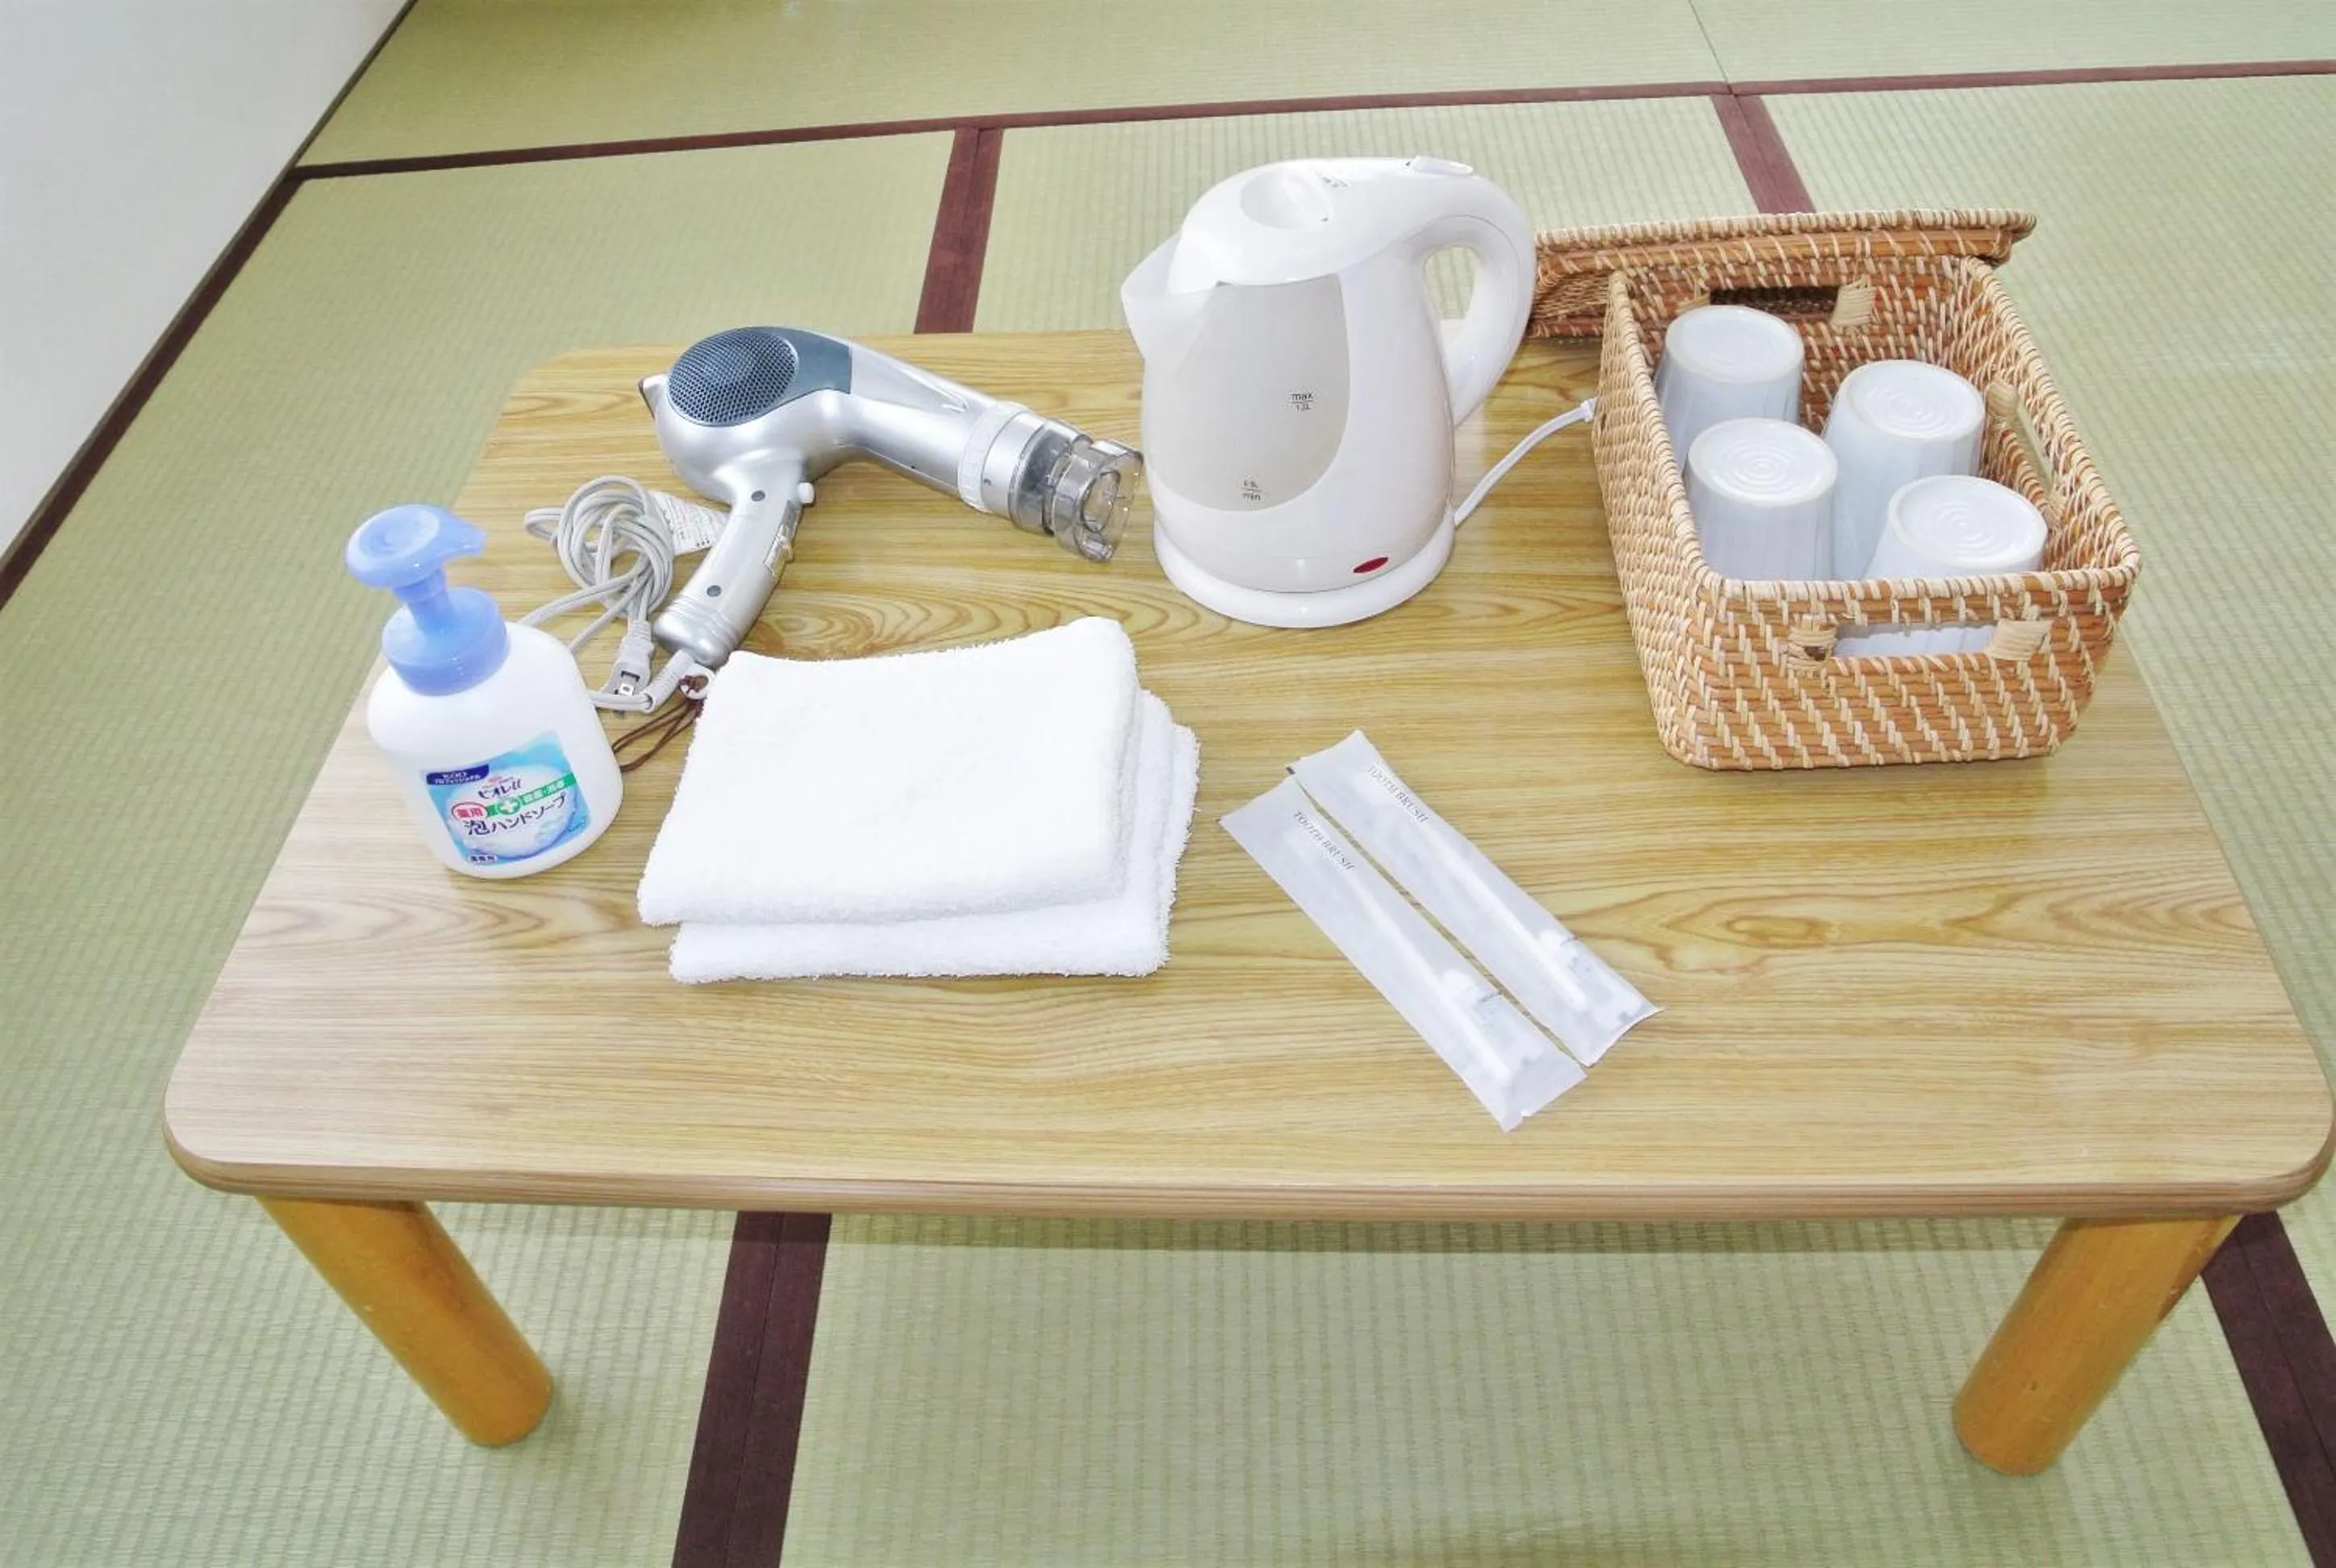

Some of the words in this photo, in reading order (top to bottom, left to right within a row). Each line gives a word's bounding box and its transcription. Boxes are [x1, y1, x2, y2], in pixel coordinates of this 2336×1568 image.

[1291, 393, 1313, 401] max
[1242, 492, 1261, 501] min
[464, 792, 566, 836] 泡ハンドソープ
[1396, 791, 1429, 824] BRUSH
[1323, 840, 1355, 870] BRUSH
